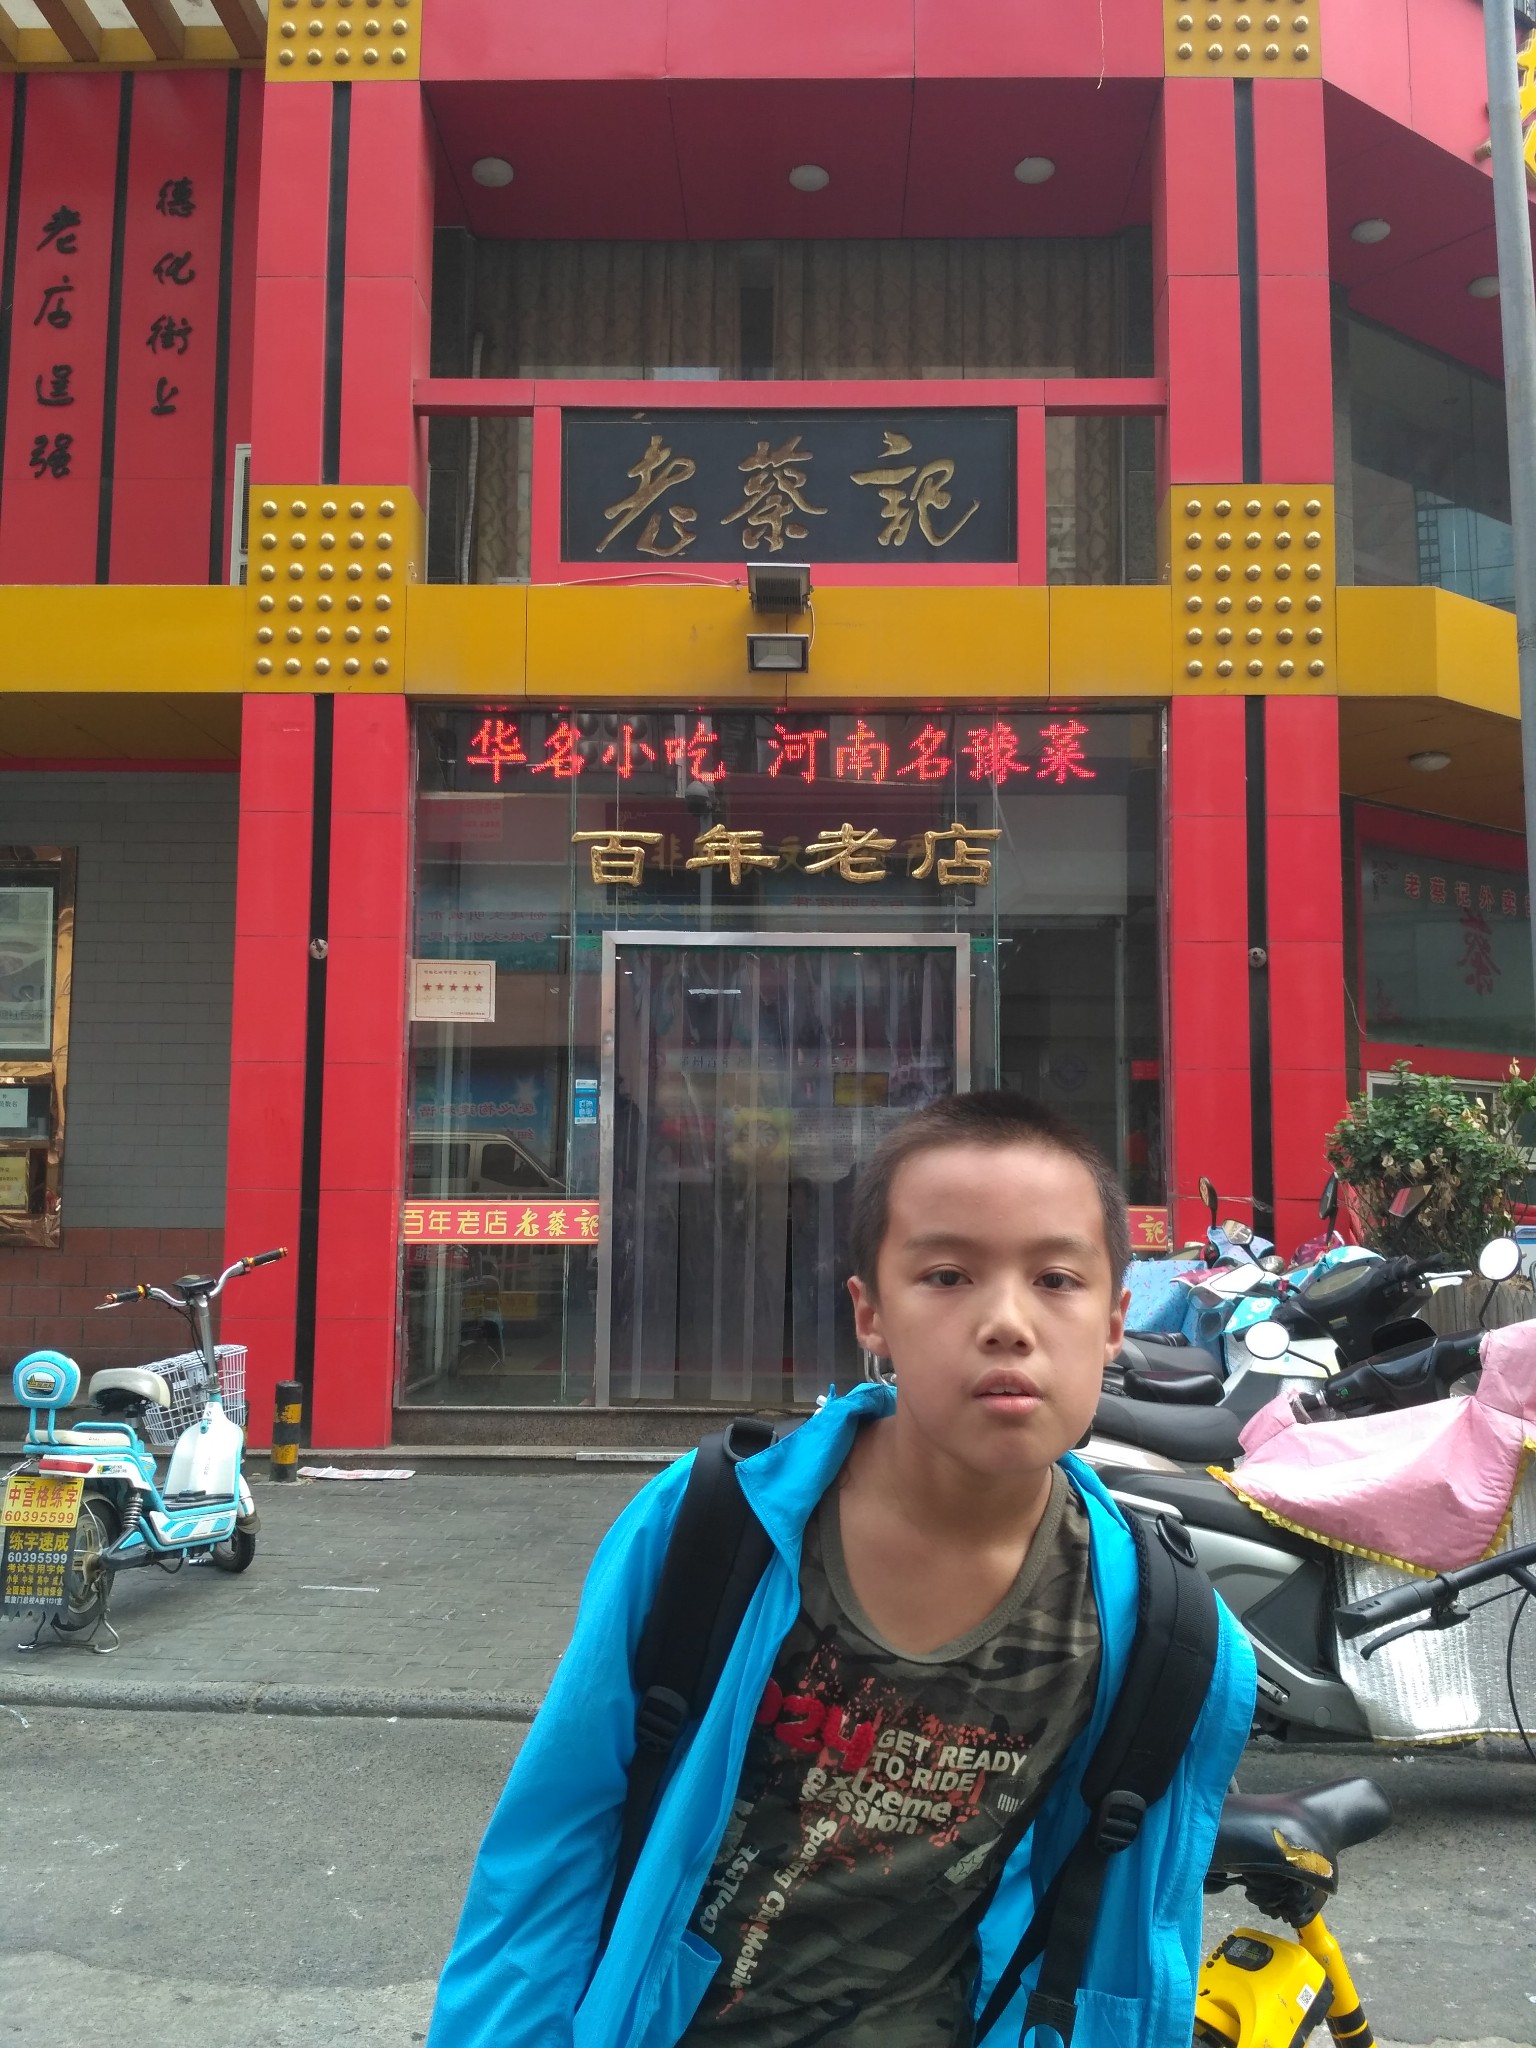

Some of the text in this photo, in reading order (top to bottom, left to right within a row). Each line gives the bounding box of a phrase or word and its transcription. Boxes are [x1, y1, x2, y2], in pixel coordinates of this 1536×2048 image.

[146, 176, 196, 415] 德化街上
[29, 205, 82, 479] 老店逞强
[466, 718, 1098, 783] 华名小吃 河南名豫菜
[571, 822, 1003, 887] 百年老店
[5, 1510, 74, 1523] 60395599
[9, 1485, 79, 1508] 中宫格练字
[7, 1551, 68, 1564] 60395599
[9, 1530, 70, 1552] 练字速成
[7, 1563, 65, 1574] 考试专用字体
[872, 1752, 976, 1793] TO RIDE
[877, 1729, 1027, 1776] GET READY
[805, 1766, 952, 1823] extreme
[700, 1845, 761, 1935] contest
